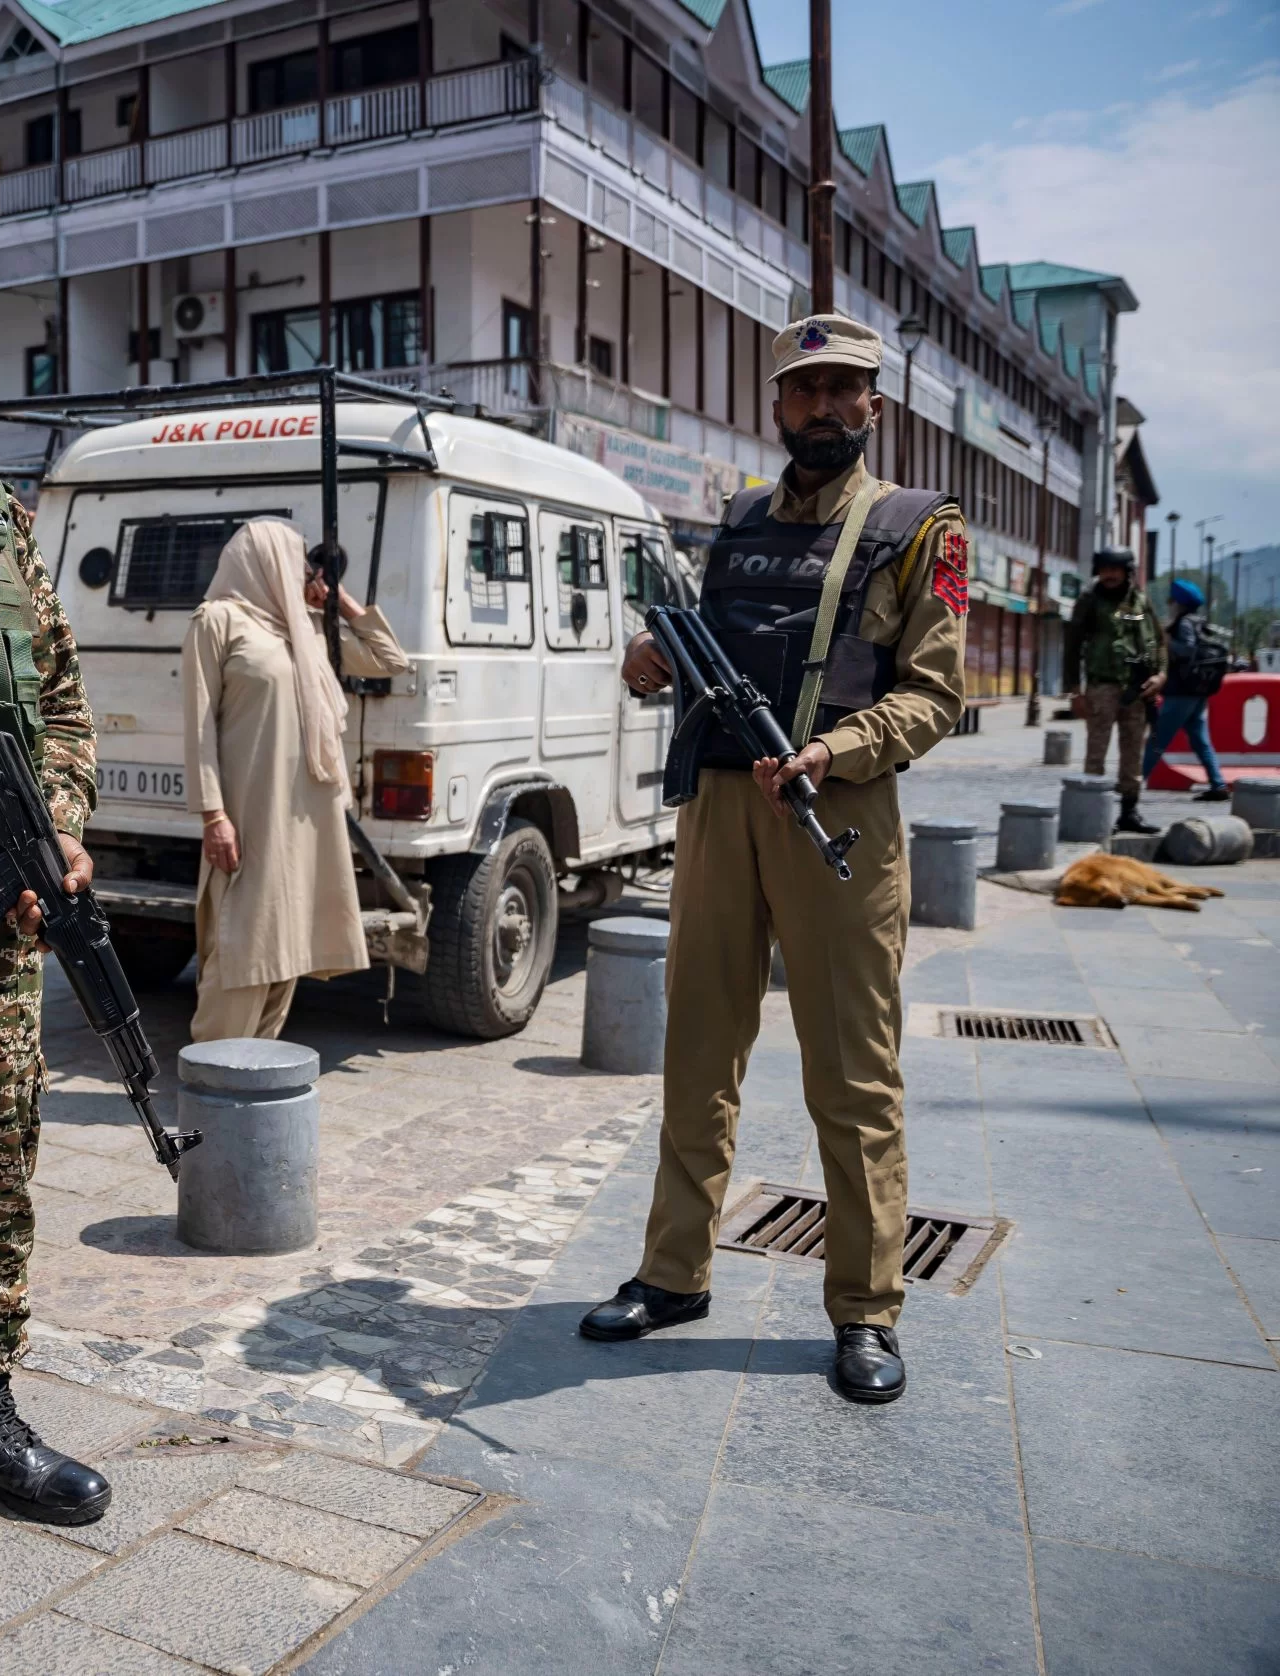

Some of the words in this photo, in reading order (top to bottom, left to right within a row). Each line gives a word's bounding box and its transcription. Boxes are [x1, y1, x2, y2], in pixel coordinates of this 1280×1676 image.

[152, 422, 210, 444] J&K
[215, 416, 318, 440] POLICE
[137, 770, 184, 796] 0105
